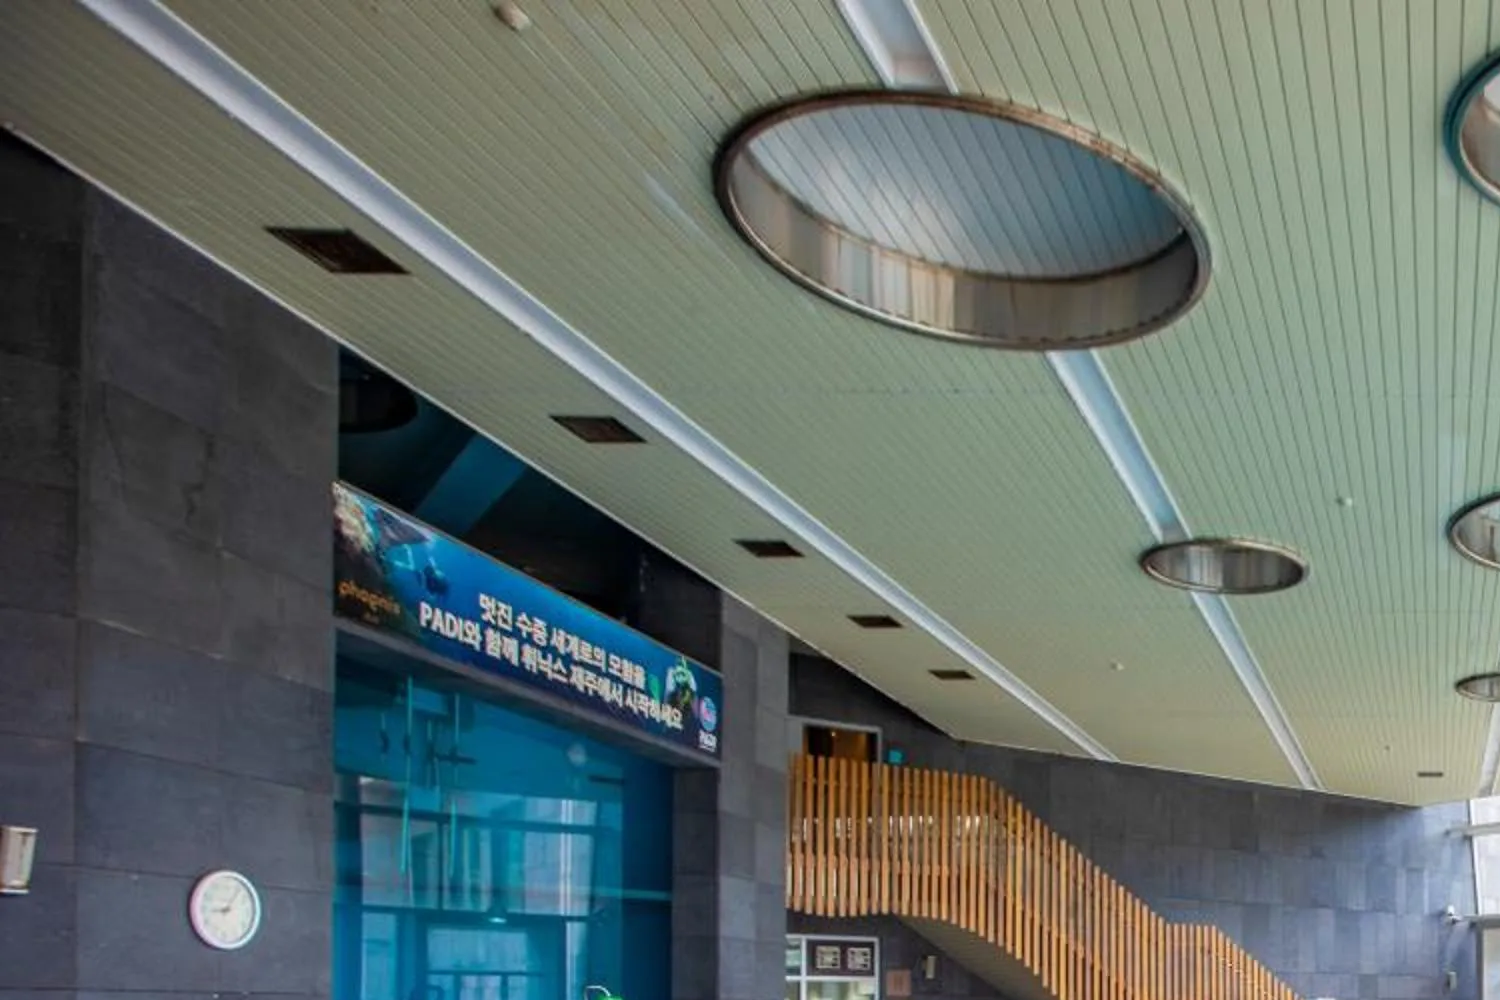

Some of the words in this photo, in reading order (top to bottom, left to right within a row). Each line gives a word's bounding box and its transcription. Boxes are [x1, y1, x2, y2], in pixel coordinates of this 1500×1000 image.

[419, 601, 482, 652] PADI와
[485, 627, 519, 667] 함께
[520, 643, 569, 684] 휘닉스
[569, 664, 623, 708] 제주에서
[625, 687, 682, 730] 시작하세요
[479, 592, 513, 632] 멋진
[516, 612, 547, 647] 수중
[550, 627, 606, 673] 세계로의
